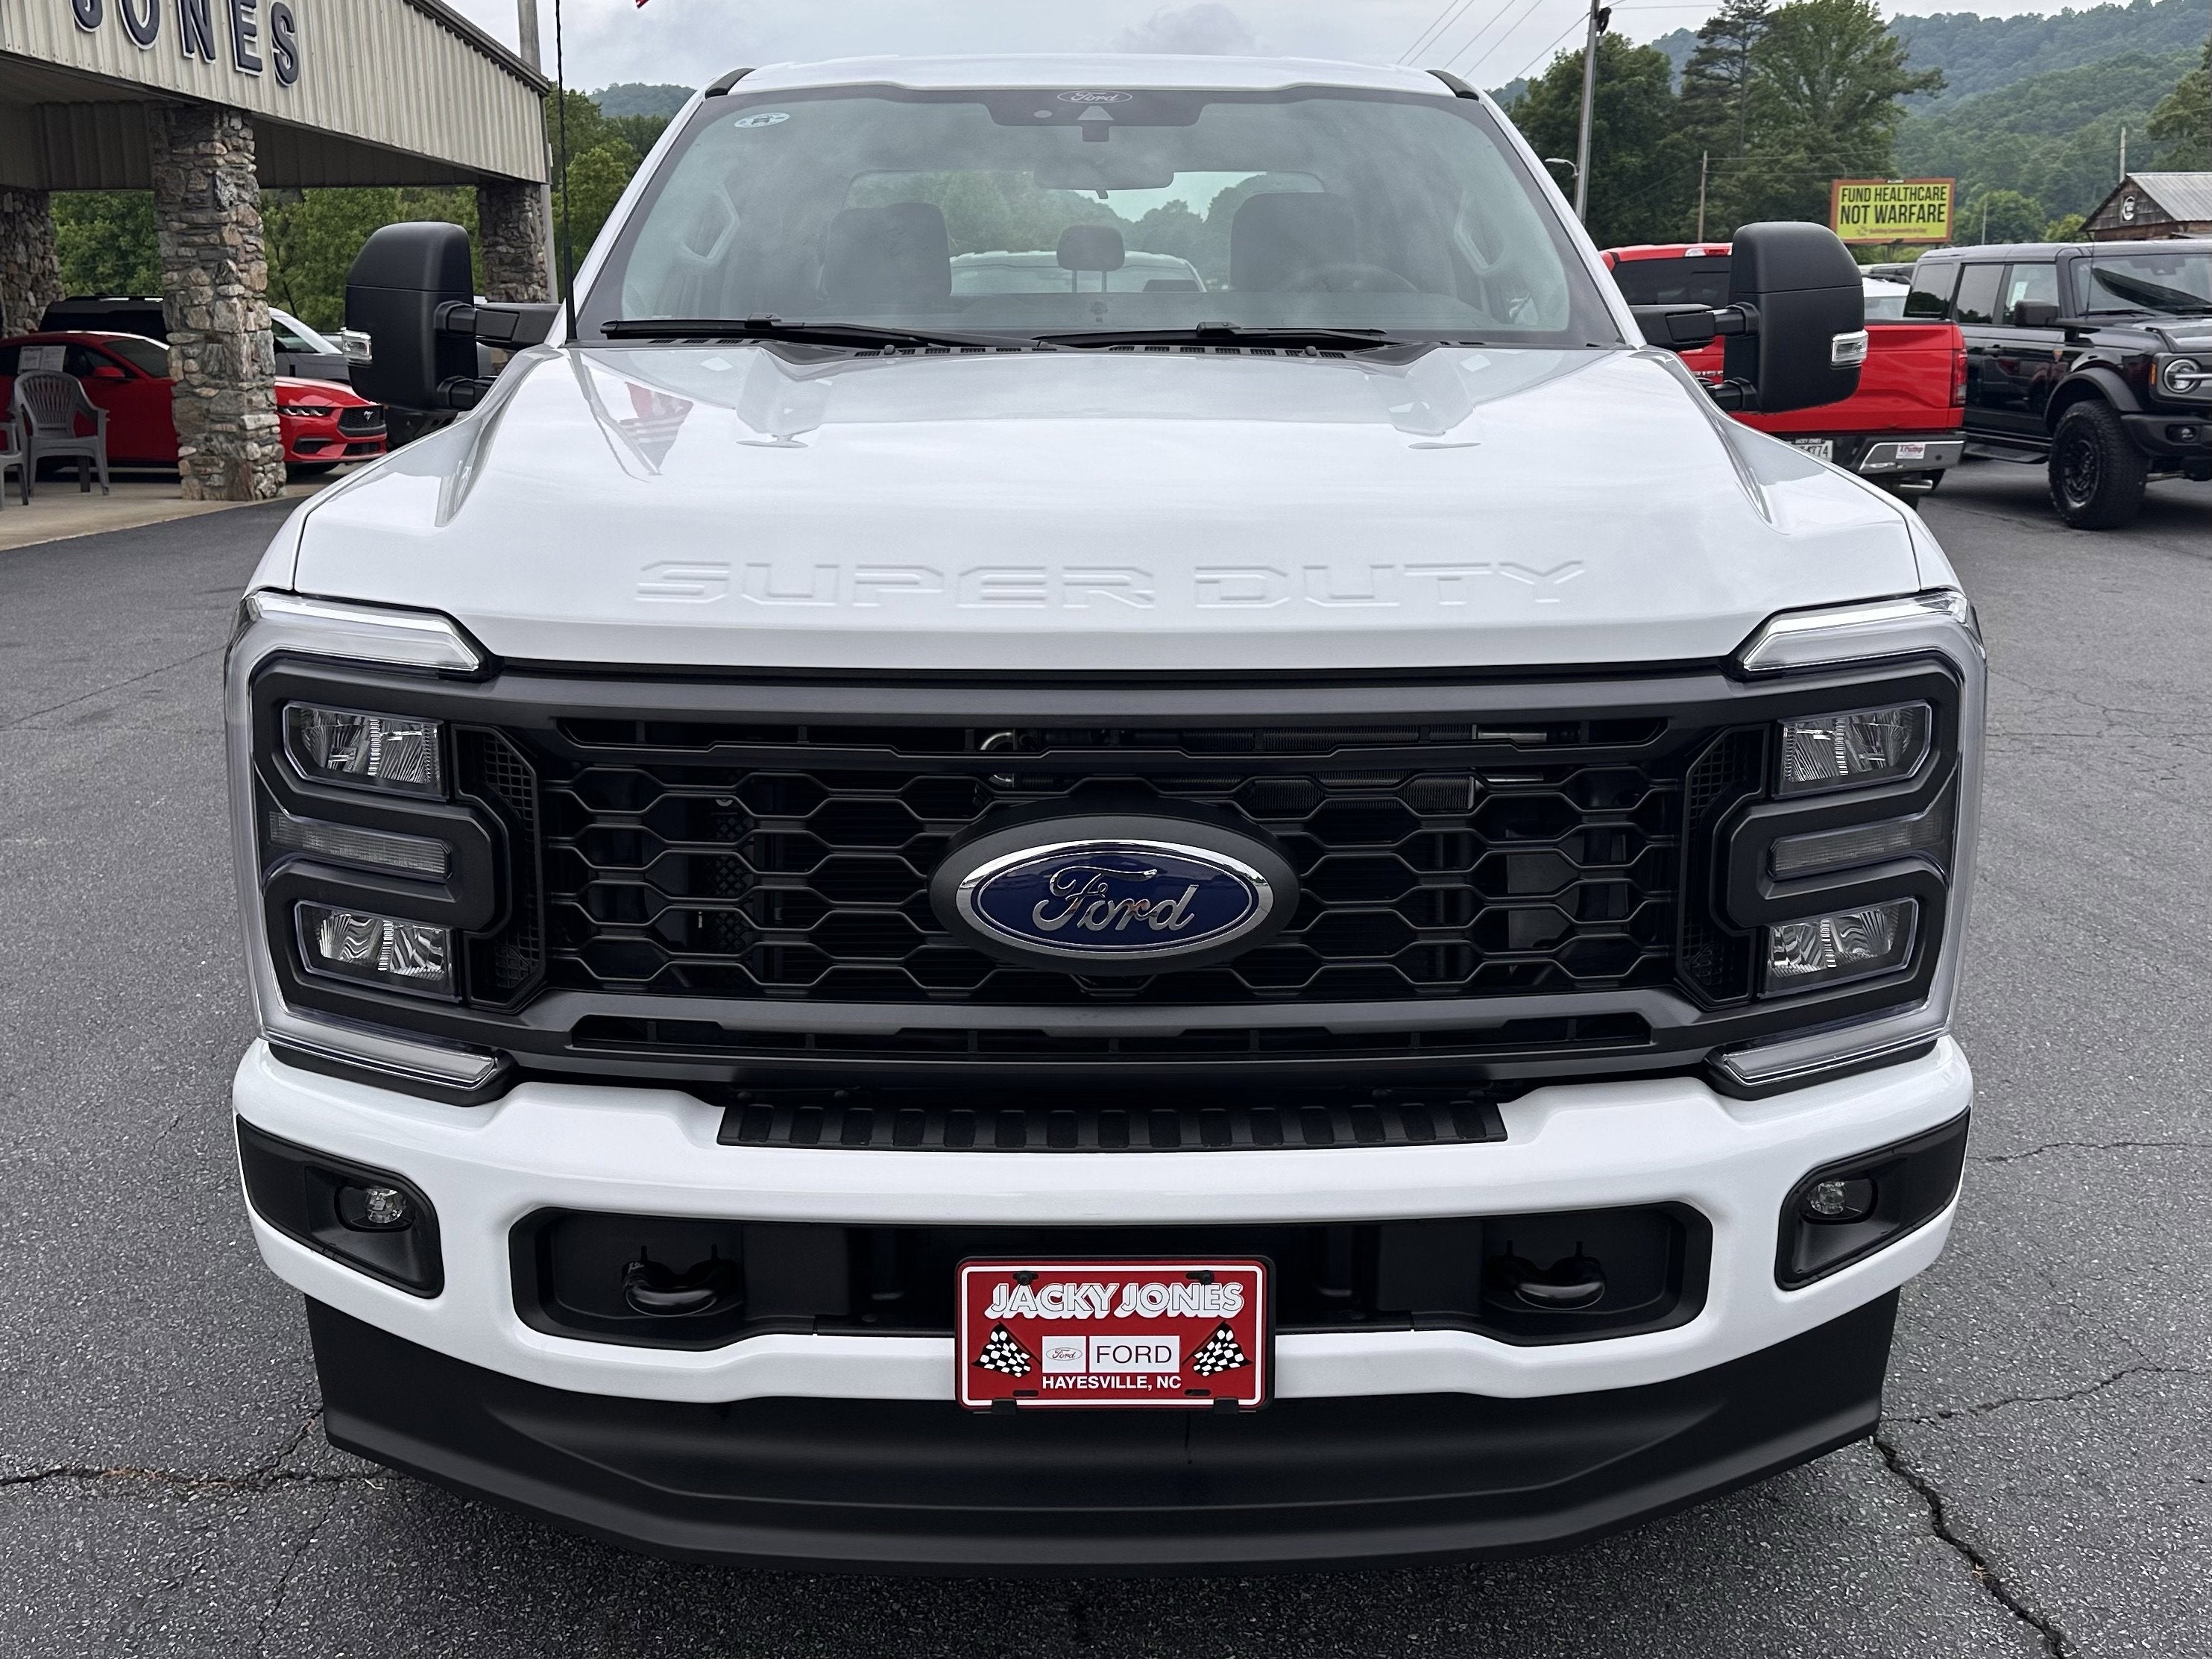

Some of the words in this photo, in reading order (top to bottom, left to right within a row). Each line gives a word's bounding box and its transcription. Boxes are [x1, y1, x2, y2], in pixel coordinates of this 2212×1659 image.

[1071, 91, 1119, 101] Ford
[1841, 188, 1871, 203] FUND
[1874, 186, 1947, 202] HEALTHCARE
[1840, 204, 1871, 224] NOT
[1874, 204, 1947, 224] WARFARE
[637, 560, 1156, 608] SUPER
[1194, 560, 1586, 608] DUTY
[1032, 866, 1200, 931] Ford
[984, 1282, 1120, 1319] JACKY
[1113, 1282, 1245, 1319] JONES
[1052, 1349, 1076, 1359] Ford
[1097, 1345, 1172, 1364] FORD
[1042, 1376, 1153, 1391] HAYESVILLE,
[1156, 1376, 1182, 1389] NC
